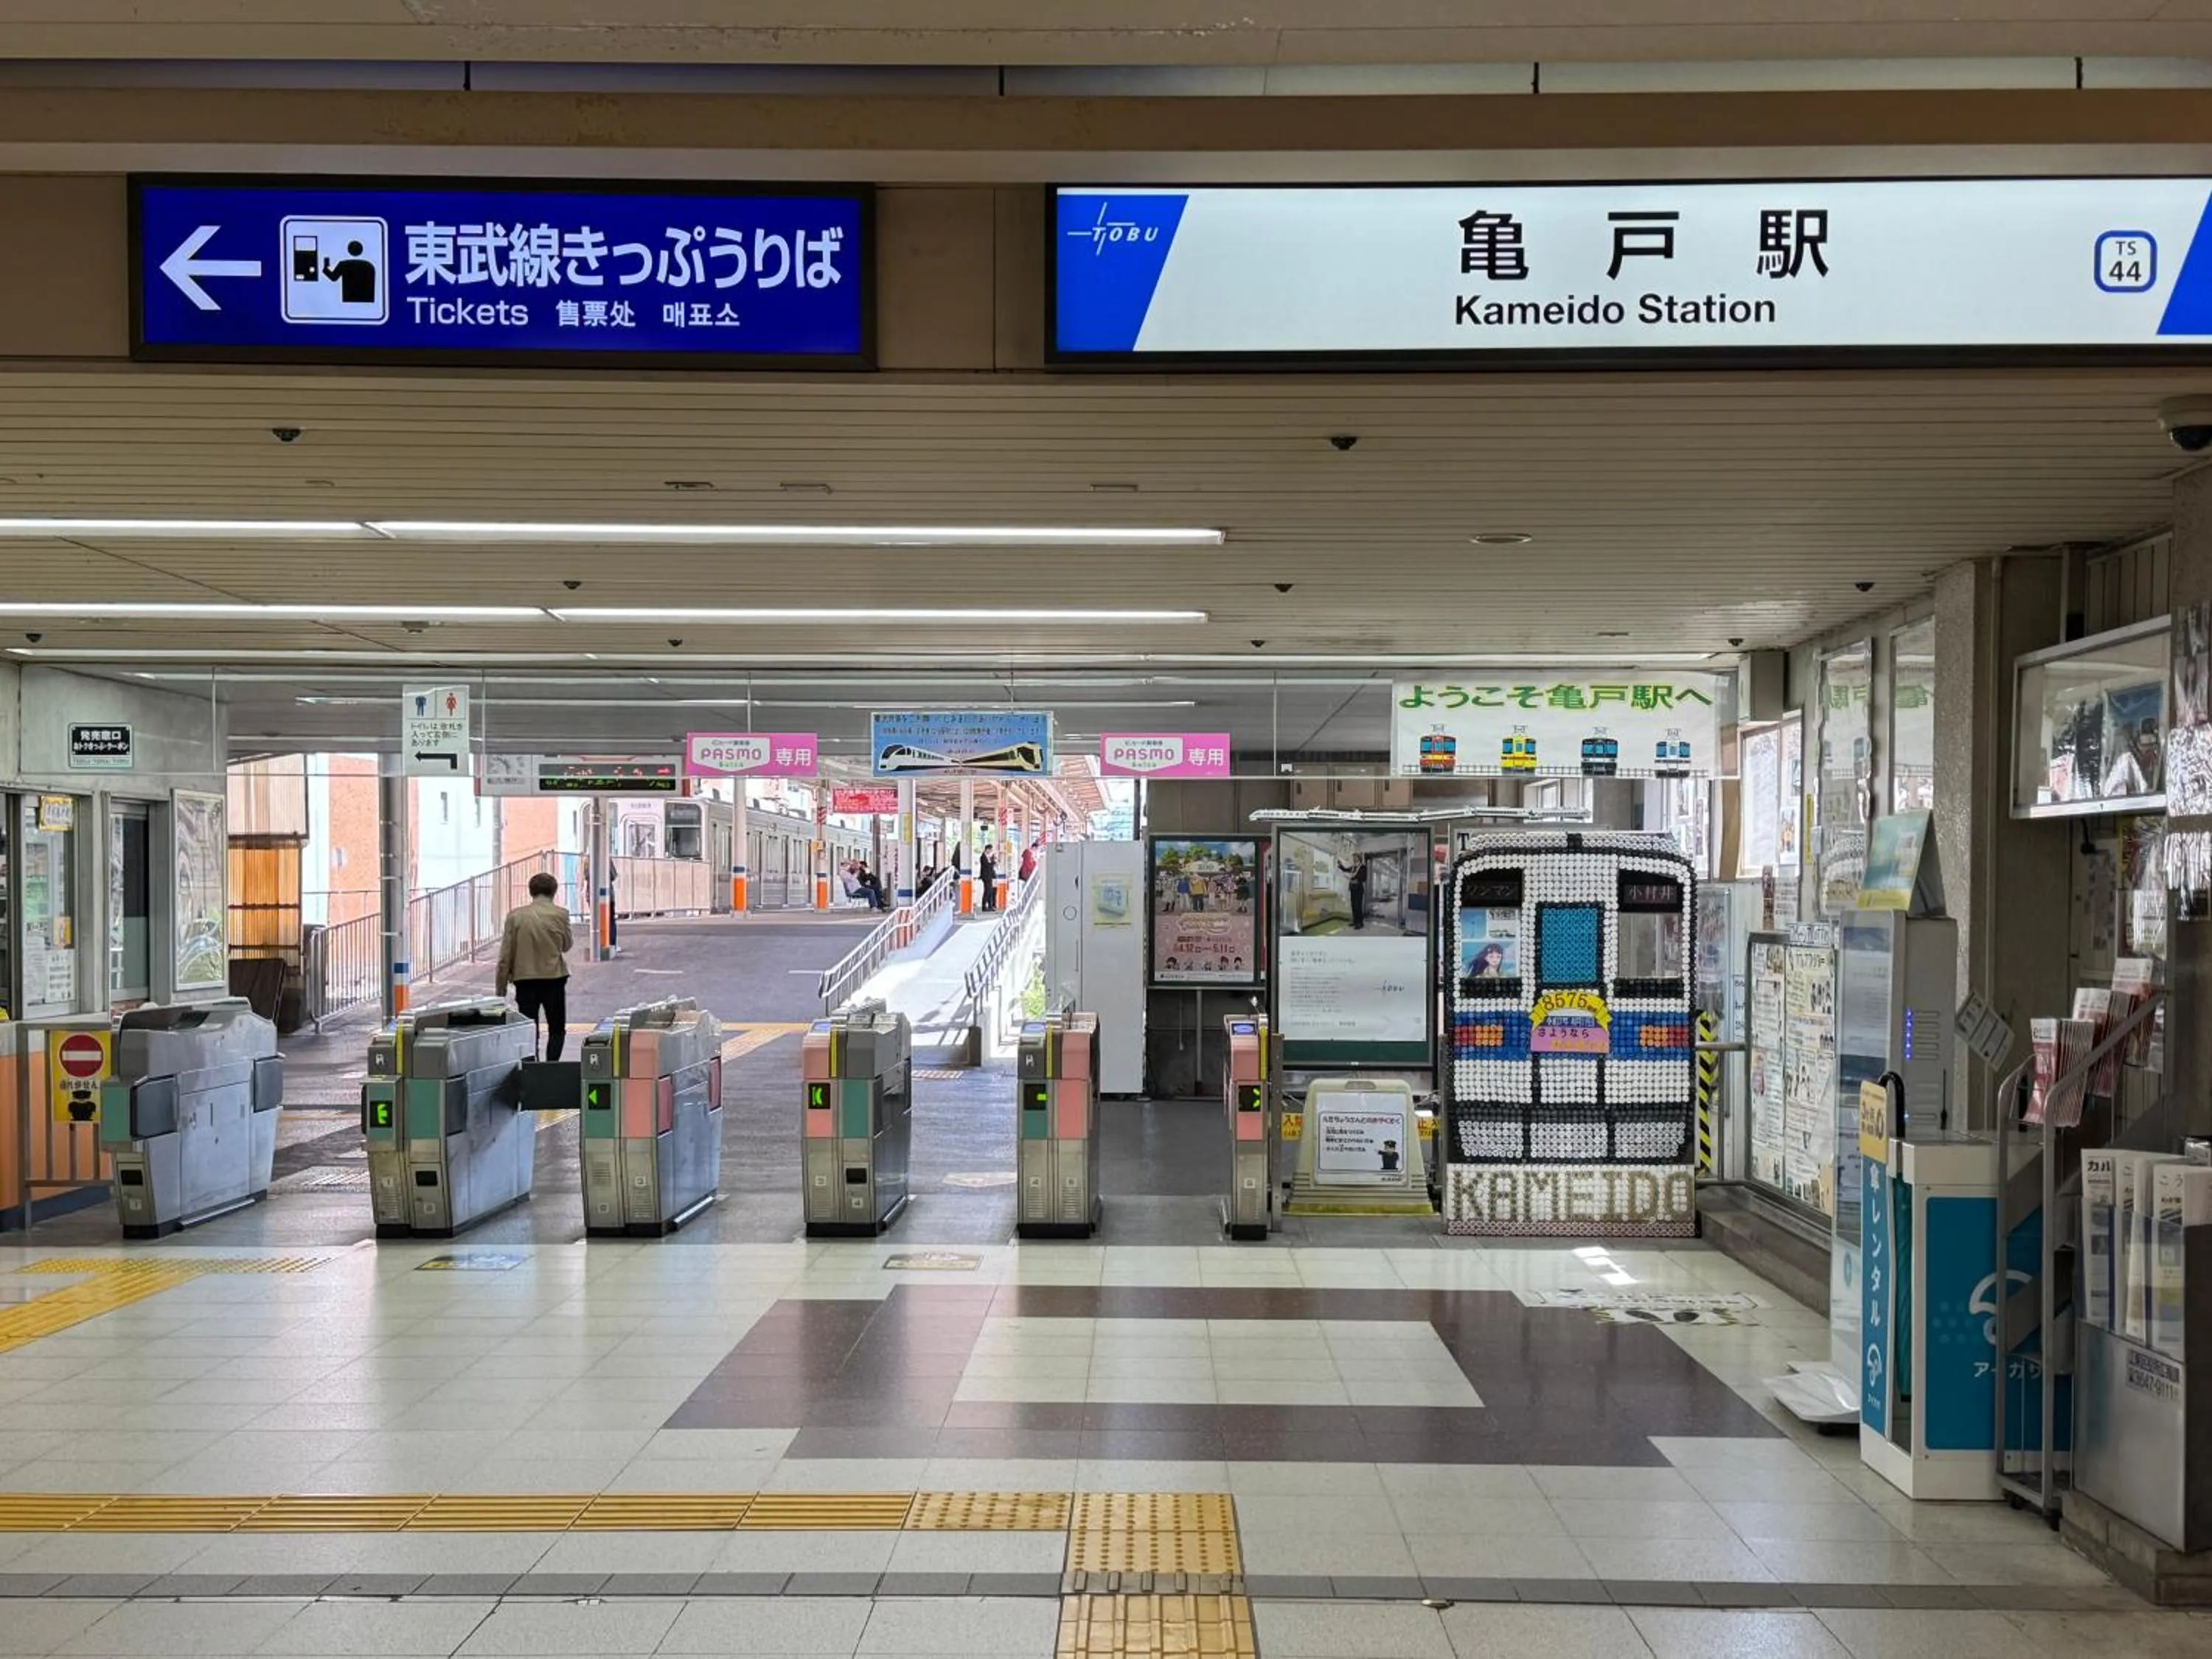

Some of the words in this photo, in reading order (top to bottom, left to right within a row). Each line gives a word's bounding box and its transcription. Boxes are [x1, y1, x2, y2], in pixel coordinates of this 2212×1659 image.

[405, 221, 843, 288] 東武線きっぷうりば
[1458, 209, 1829, 280] 亀戸駅
[2115, 240, 2137, 256] TS
[2109, 260, 2141, 282] 44
[407, 296, 529, 327] Tickets
[555, 300, 636, 328] 售票处
[662, 302, 740, 329] 매표소
[1454, 294, 1625, 327] Kameido
[1638, 293, 1776, 325] Station
[1399, 684, 1712, 709] ようこそ亀戸駅へ
[701, 748, 762, 760] PASMO
[775, 748, 811, 766] 専用
[1114, 748, 1175, 760] PASMO
[1188, 748, 1224, 766] 専用
[1543, 992, 1588, 1010] 8575
[1451, 1170, 1694, 1222] KAMEIDO
